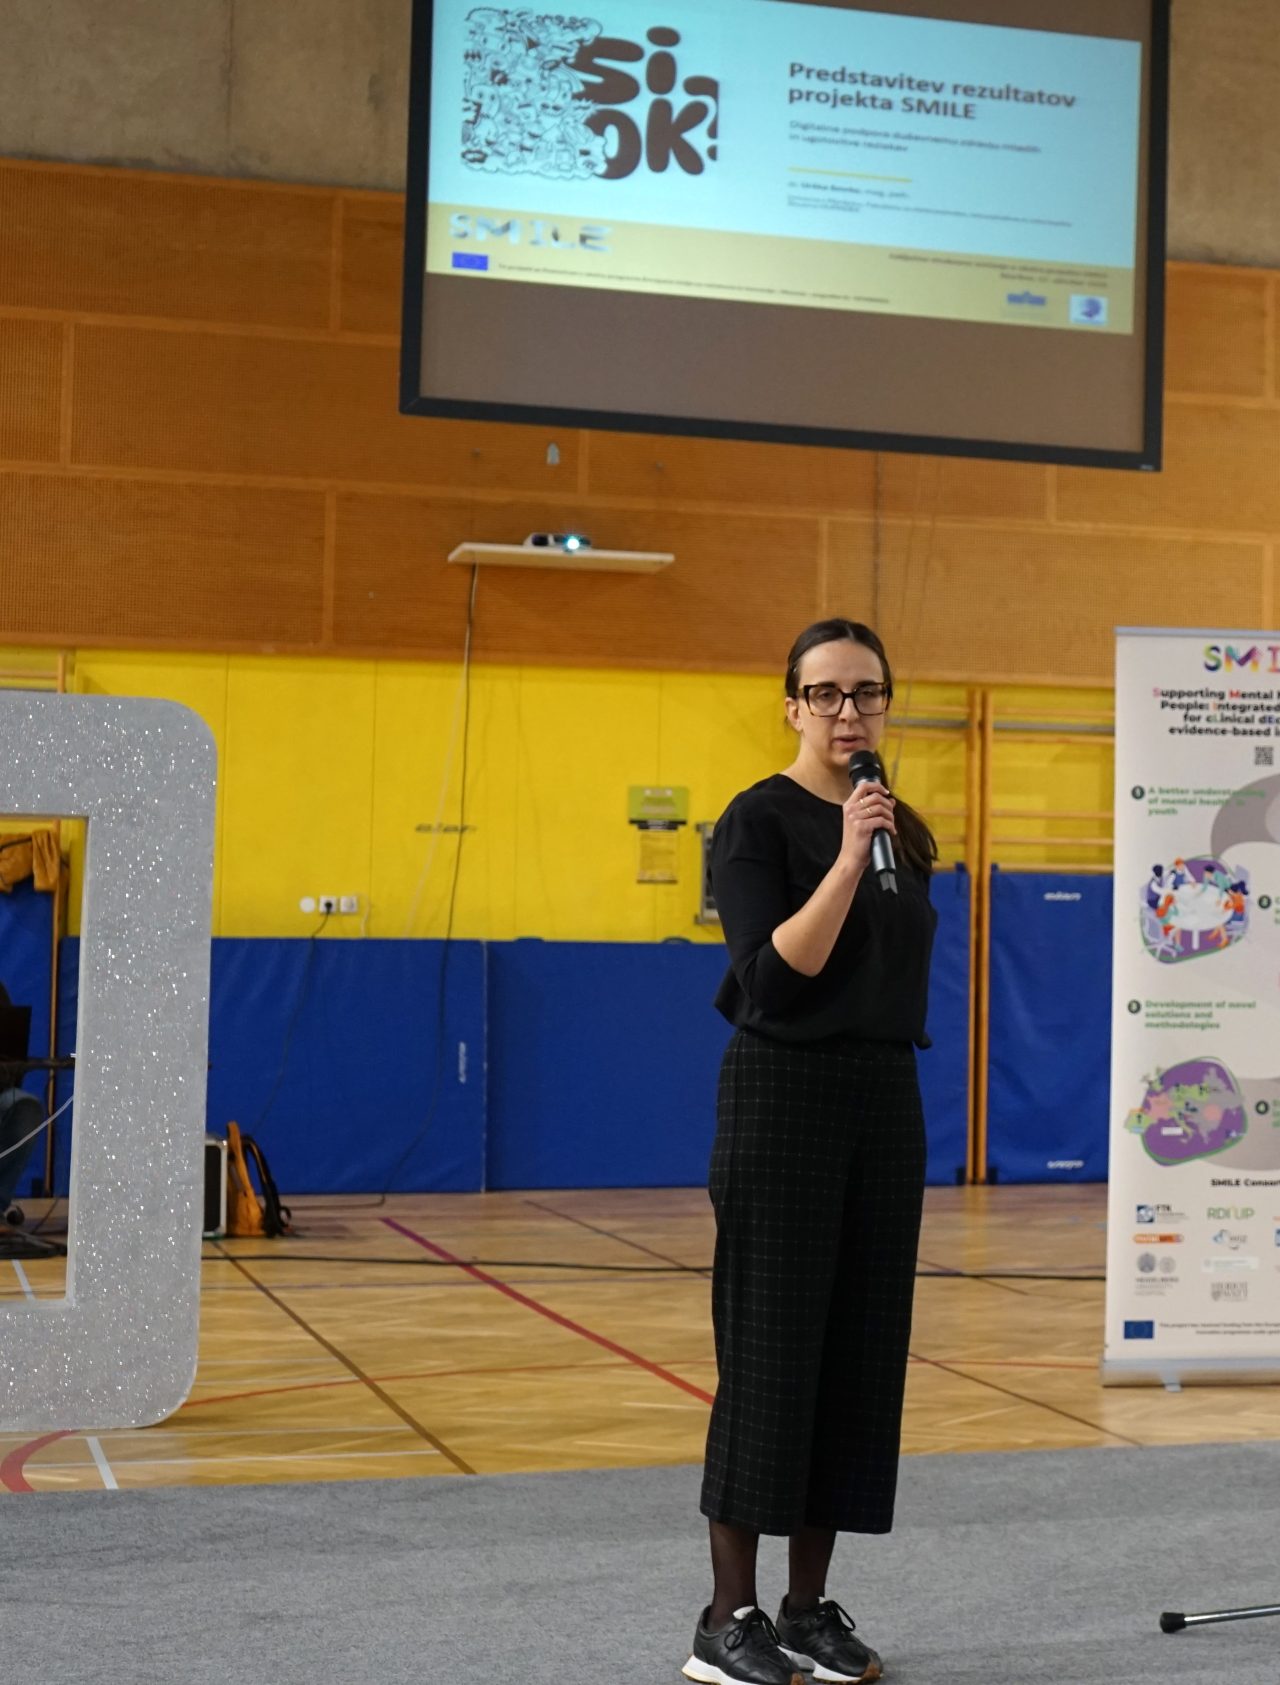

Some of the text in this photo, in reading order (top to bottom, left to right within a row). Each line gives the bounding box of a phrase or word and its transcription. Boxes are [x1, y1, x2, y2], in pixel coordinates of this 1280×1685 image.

[789, 61, 1077, 108] Predstavitev rezultatov
[788, 87, 977, 120] projekta SMILE
[448, 212, 613, 253] SMILE
[1153, 687, 1226, 701] Supporting
[1229, 689, 1273, 699] Mental
[1161, 700, 1209, 712] People:
[1213, 702, 1280, 714] Integrated
[1183, 712, 1203, 723] for
[1168, 725, 1271, 737] evidence-based
[1210, 1178, 1241, 1187] SMILE
